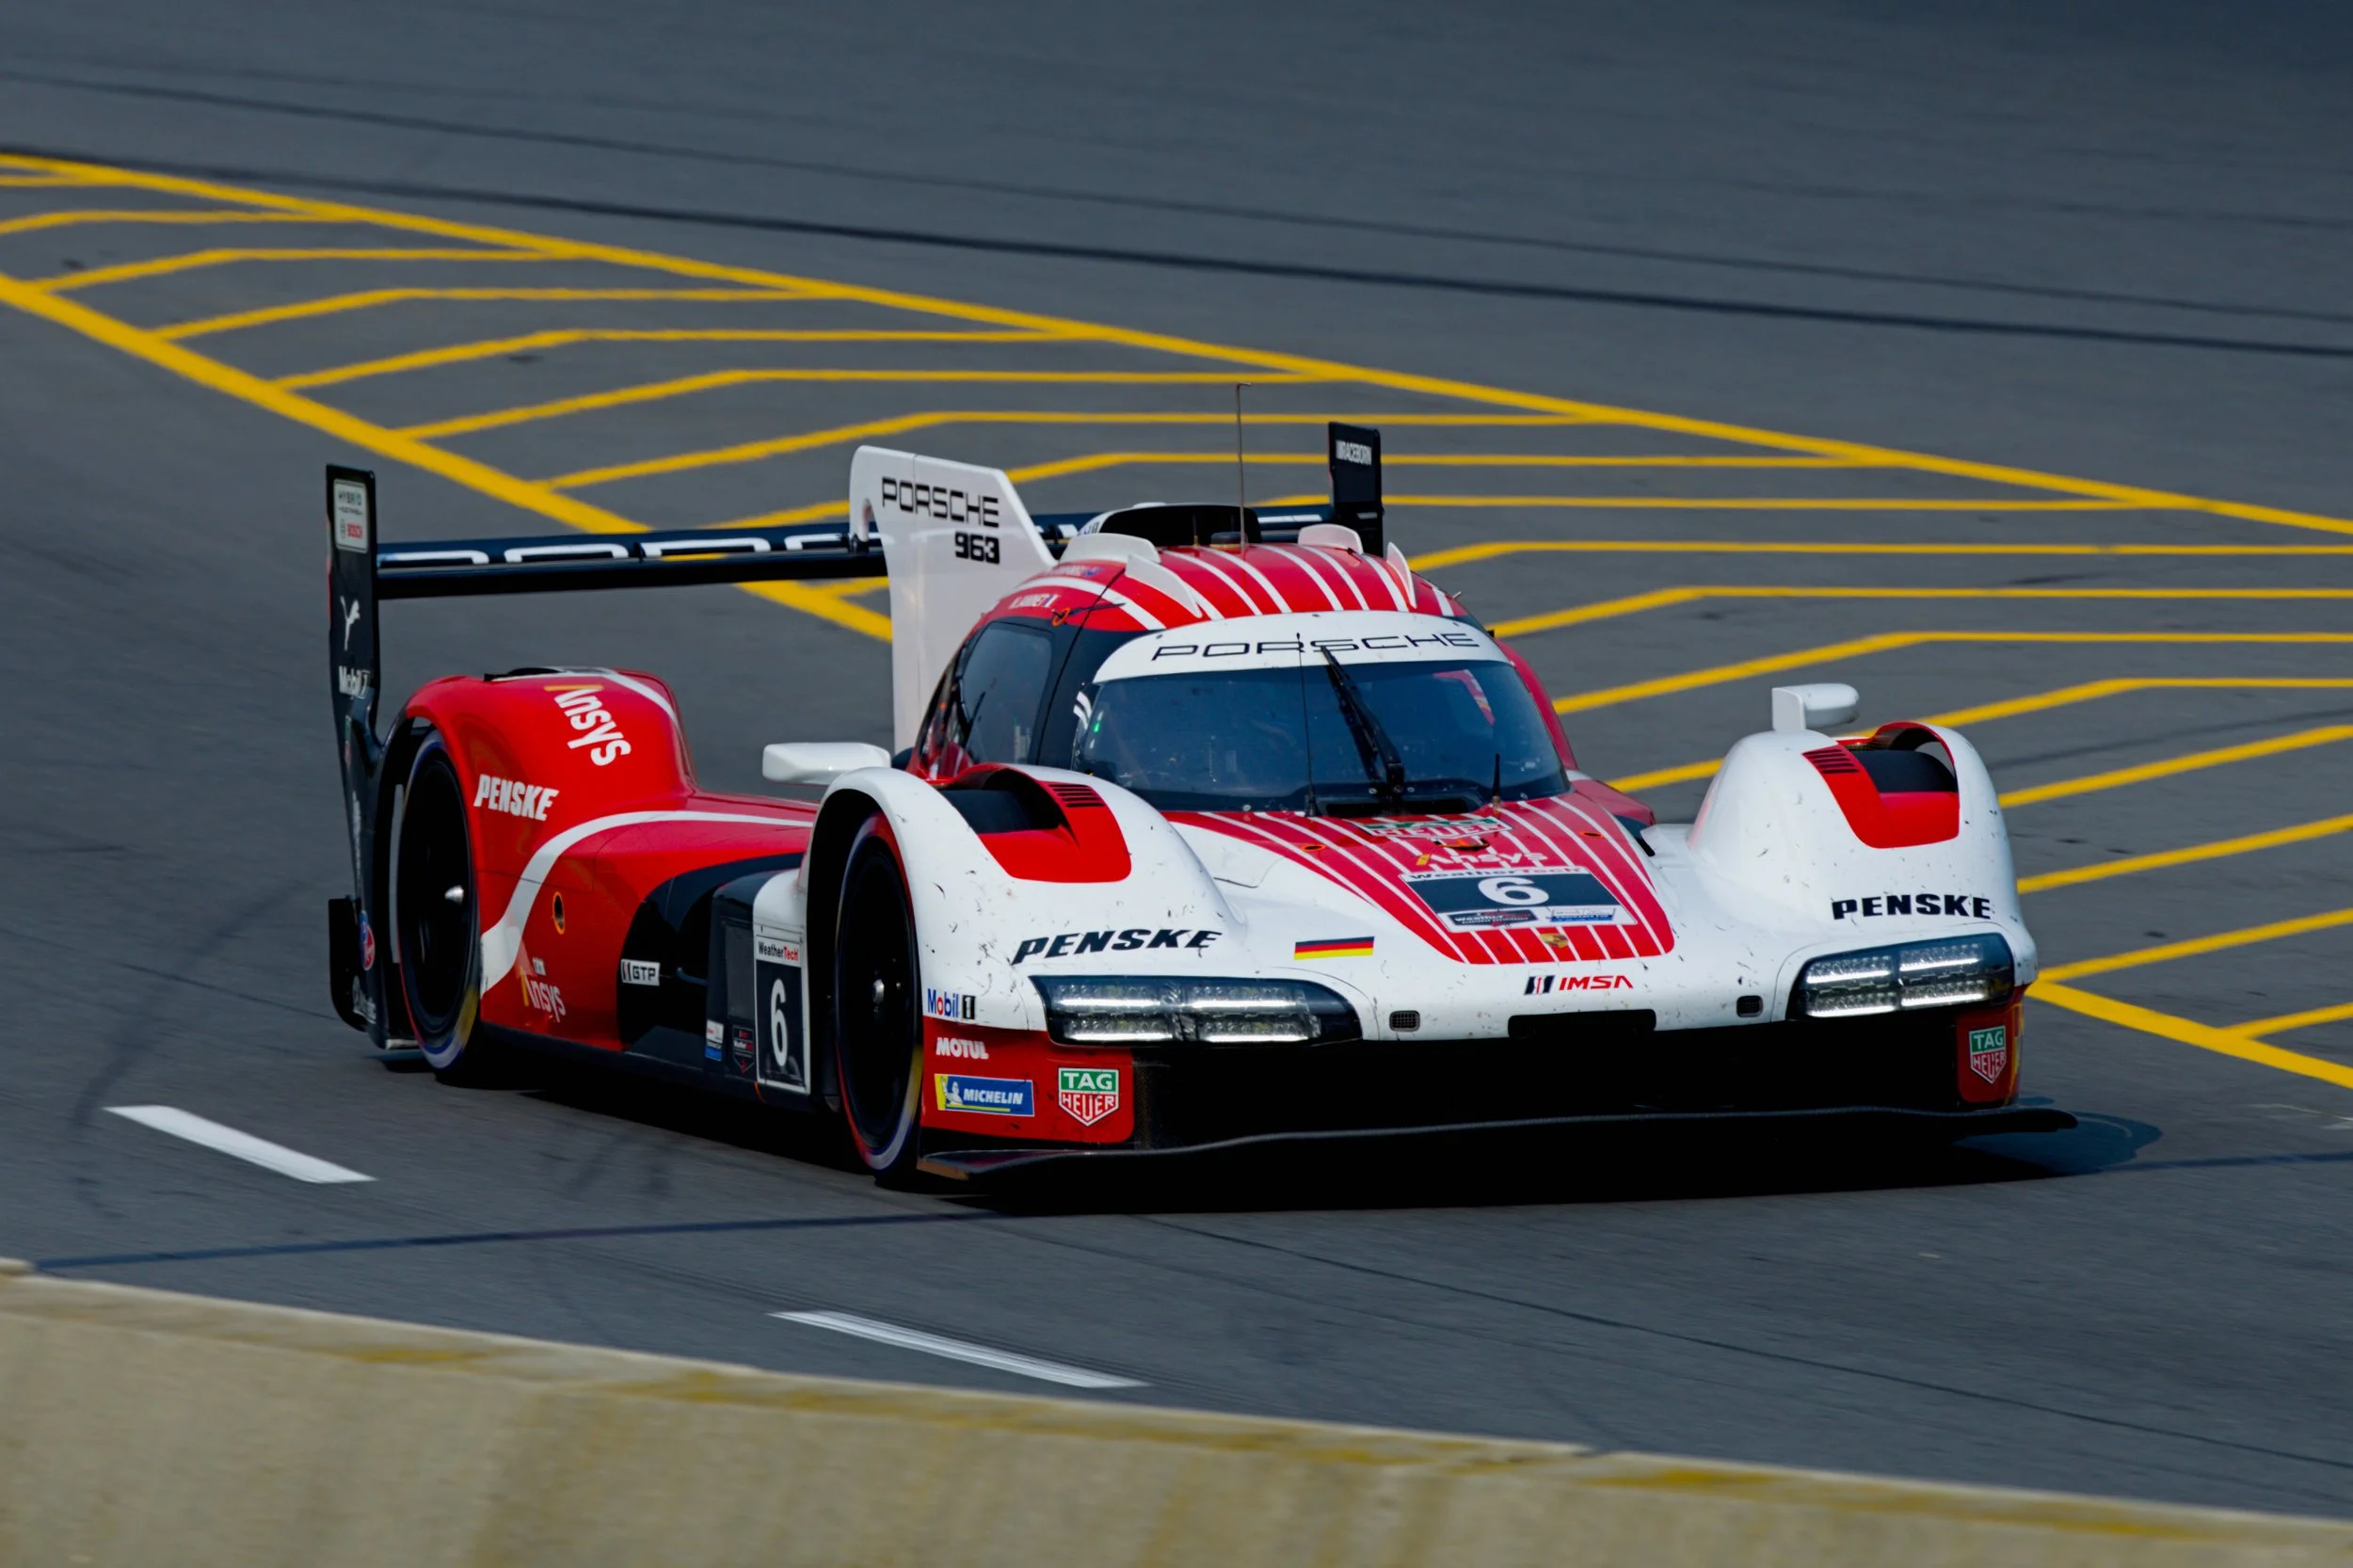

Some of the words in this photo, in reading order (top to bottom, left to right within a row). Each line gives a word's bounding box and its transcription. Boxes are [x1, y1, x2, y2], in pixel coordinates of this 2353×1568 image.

[882, 476, 1000, 529] PORSCHE
[954, 531, 1000, 565] 963
[1151, 632, 1481, 662] PORSCHE
[473, 774, 560, 822] PENSKE
[1478, 876, 1549, 905] 6
[1832, 893, 1992, 920] PENSKE
[758, 942, 799, 961] WeatherTech
[1011, 929, 1223, 966] PENSKE
[632, 966, 656, 981] GTP
[1559, 975, 1634, 990] IMSA
[927, 988, 959, 1018] Mobil
[963, 995, 975, 1020] 1
[770, 978, 789, 1066] 6
[936, 1037, 989, 1060] MOTUL
[1974, 1031, 2004, 1049] TAG
[1973, 1052, 2006, 1079] HEUER
[1064, 1072, 1113, 1090] TAG
[963, 1088, 1023, 1105] MICHELIN
[1062, 1094, 1115, 1122] HEUER
